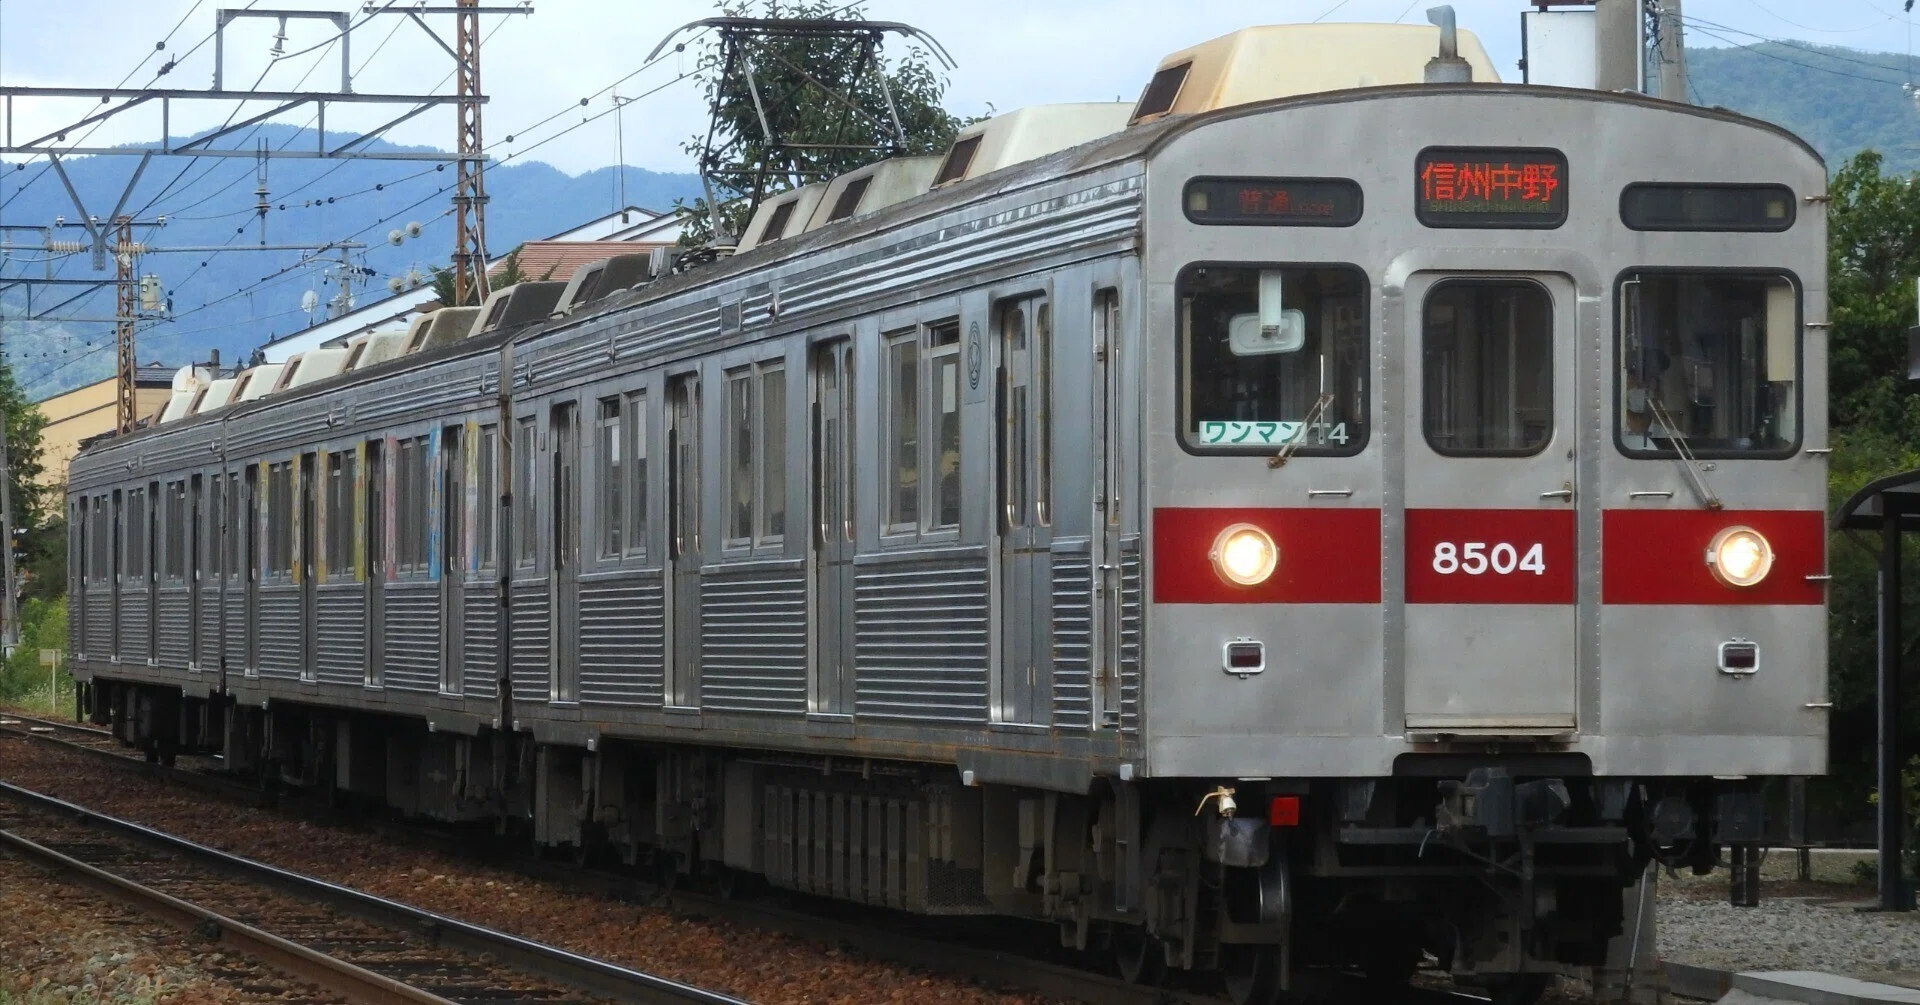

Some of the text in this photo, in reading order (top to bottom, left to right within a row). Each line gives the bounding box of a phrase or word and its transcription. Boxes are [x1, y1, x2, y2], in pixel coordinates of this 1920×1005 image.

[1421, 162, 1558, 202] 信州中野
[1205, 422, 1303, 443] ワンマン
[1432, 541, 1546, 575] 8504
